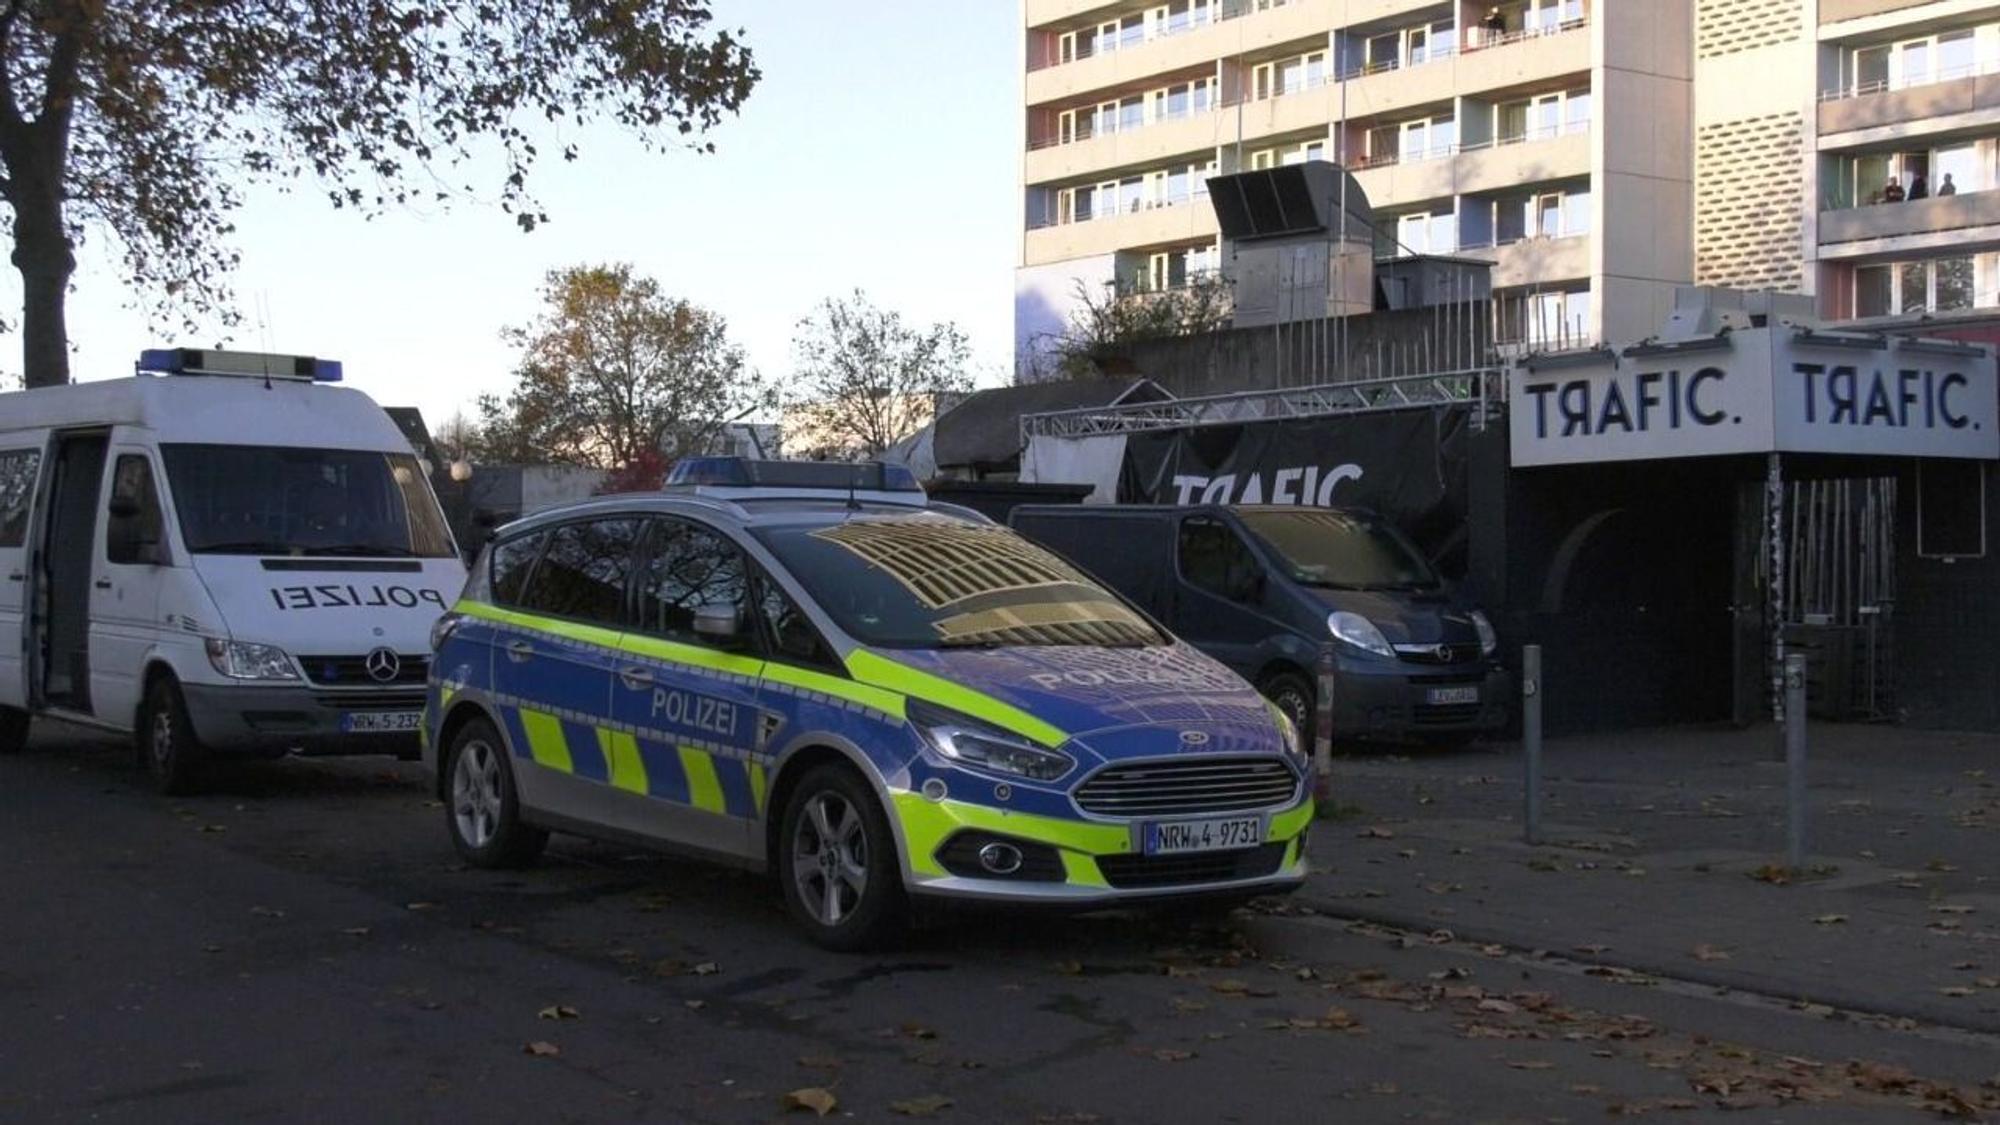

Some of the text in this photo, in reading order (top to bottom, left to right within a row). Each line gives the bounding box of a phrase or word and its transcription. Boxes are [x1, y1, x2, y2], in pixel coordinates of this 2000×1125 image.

[1029, 668, 1218, 690] POLIZE
[651, 687, 737, 736] POLIZEI
[1158, 824, 1191, 849] NRW
